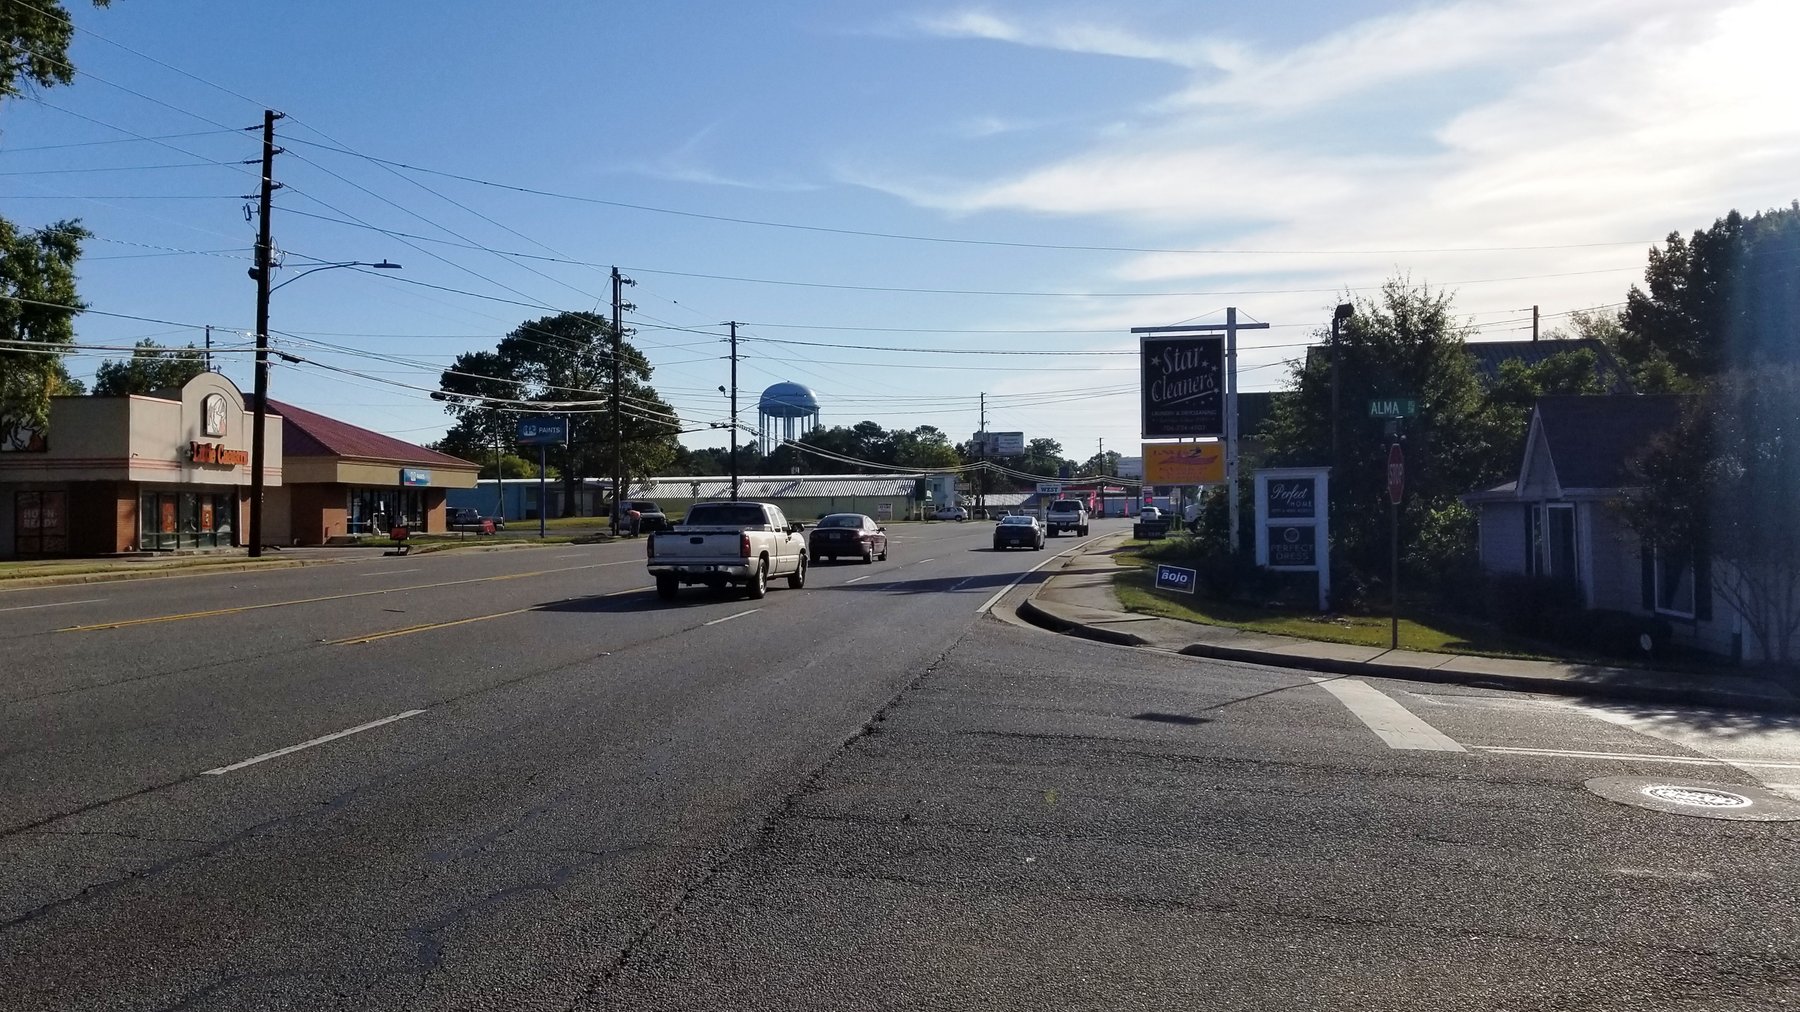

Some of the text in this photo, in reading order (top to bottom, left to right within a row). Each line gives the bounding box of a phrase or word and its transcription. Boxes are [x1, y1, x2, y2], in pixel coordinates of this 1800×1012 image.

[1162, 347, 1203, 375] Star
[1151, 373, 1214, 402] Cleaners
[1371, 401, 1399, 415] ALMA
[1271, 483, 1308, 504] Perfect
[1290, 500, 1313, 508] HOME
[1271, 543, 1313, 552] PERFECT
[1276, 552, 1309, 561] DRESS
